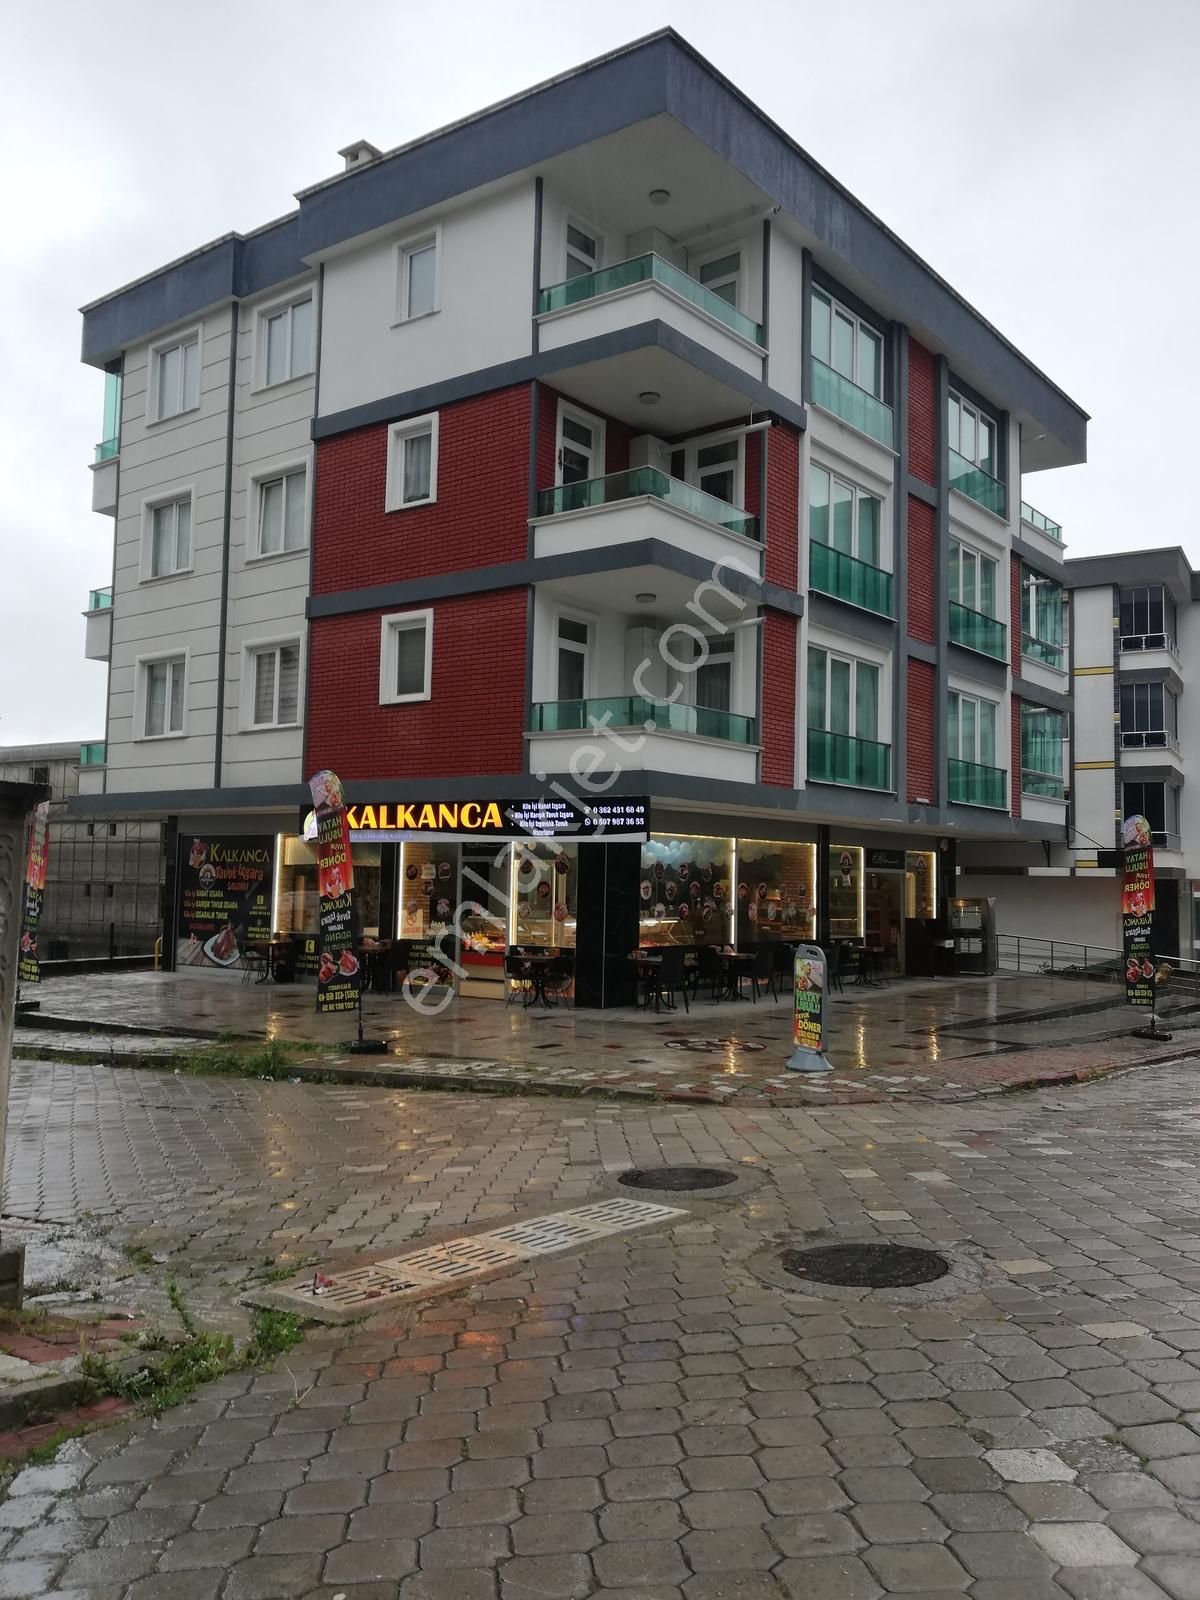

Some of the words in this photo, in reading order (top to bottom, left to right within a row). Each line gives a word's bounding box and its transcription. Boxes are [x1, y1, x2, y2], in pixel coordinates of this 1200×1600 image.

[593, 806, 598, 814] 0
[598, 806, 612, 814] 362
[612, 806, 625, 814] 431
[625, 806, 635, 814] 68
[635, 805, 645, 814] 49
[210, 843, 270, 863] KALKANCA
